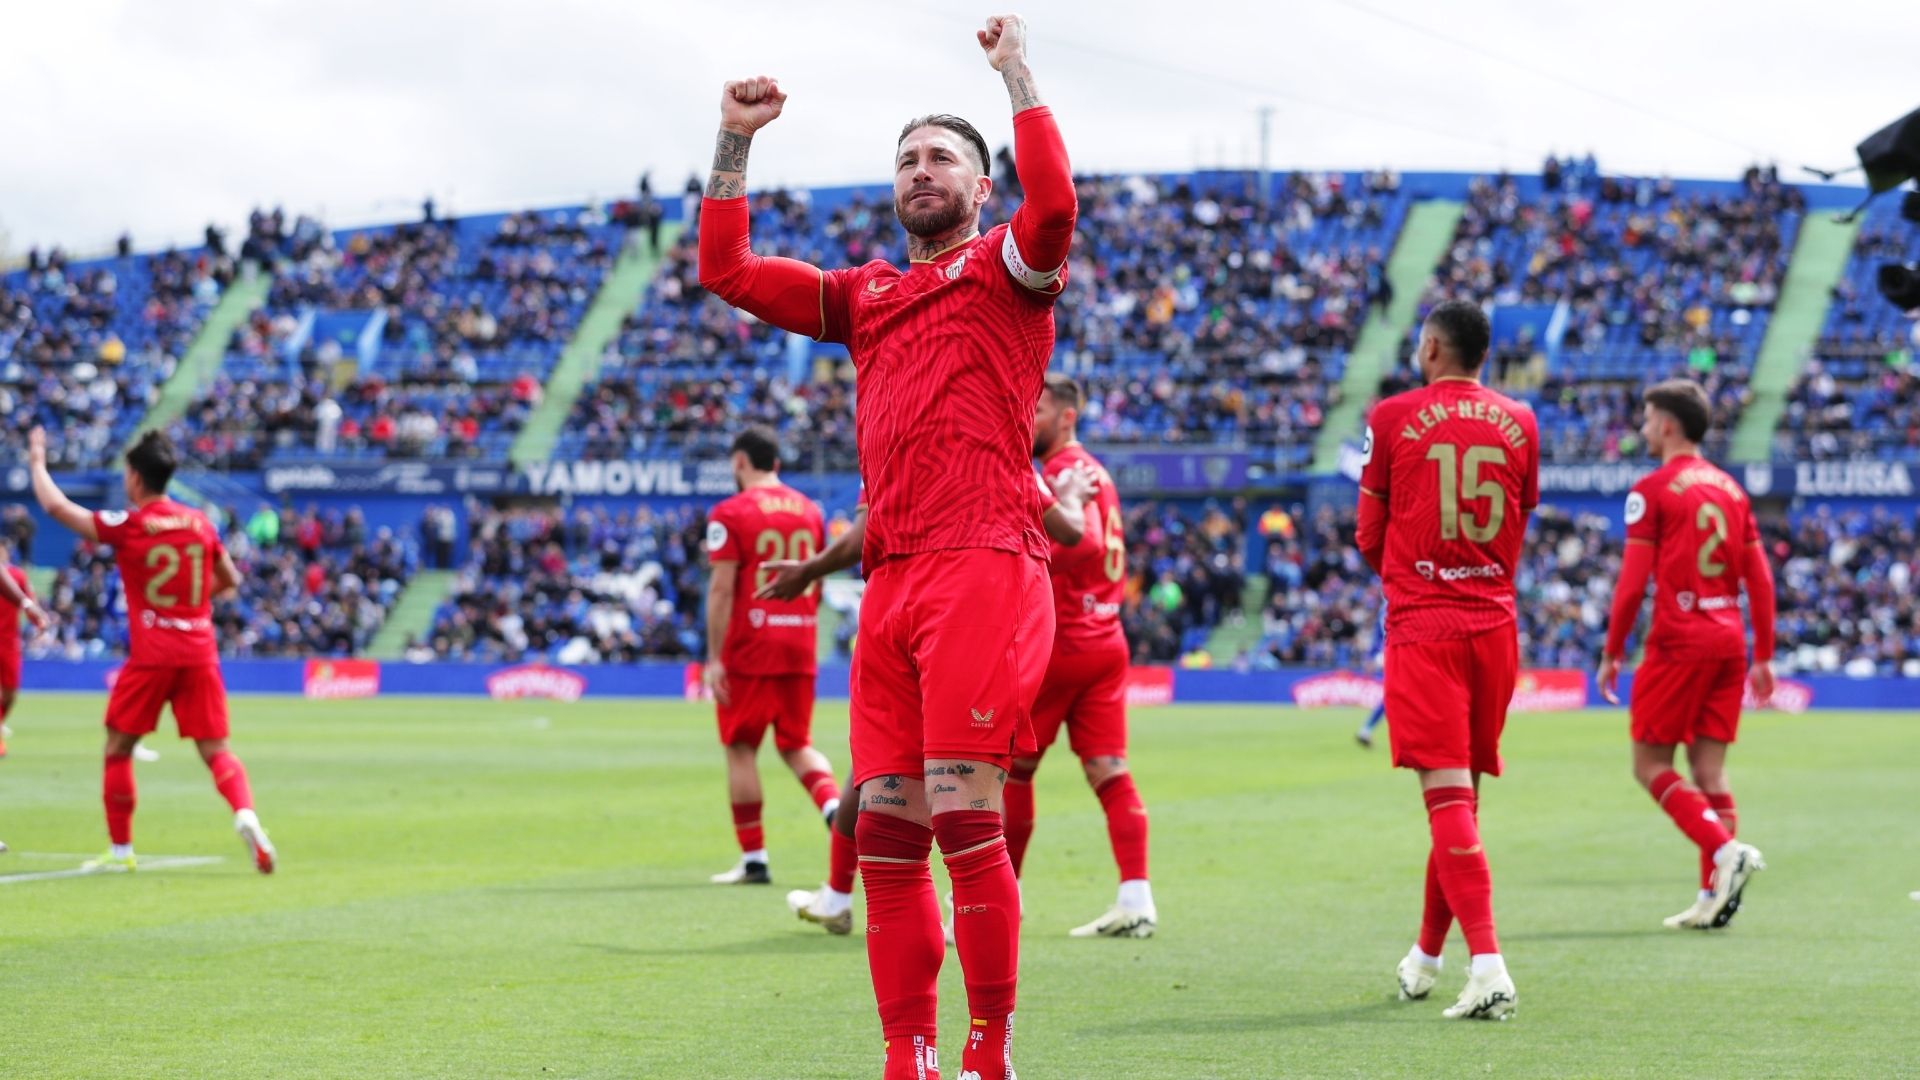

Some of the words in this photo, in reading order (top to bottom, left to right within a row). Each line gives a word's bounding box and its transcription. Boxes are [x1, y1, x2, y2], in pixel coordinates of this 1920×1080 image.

[527, 460, 692, 495] YAMOVIL
[1425, 443, 1507, 543] 15
[1796, 460, 1914, 496] LUJISA
[756, 529, 815, 597] 20
[1105, 505, 1124, 582] 6
[1697, 502, 1728, 577] 2
[146, 543, 203, 608] 21
[971, 1030, 983, 1041] SR
[971, 1041, 977, 1050] 4
